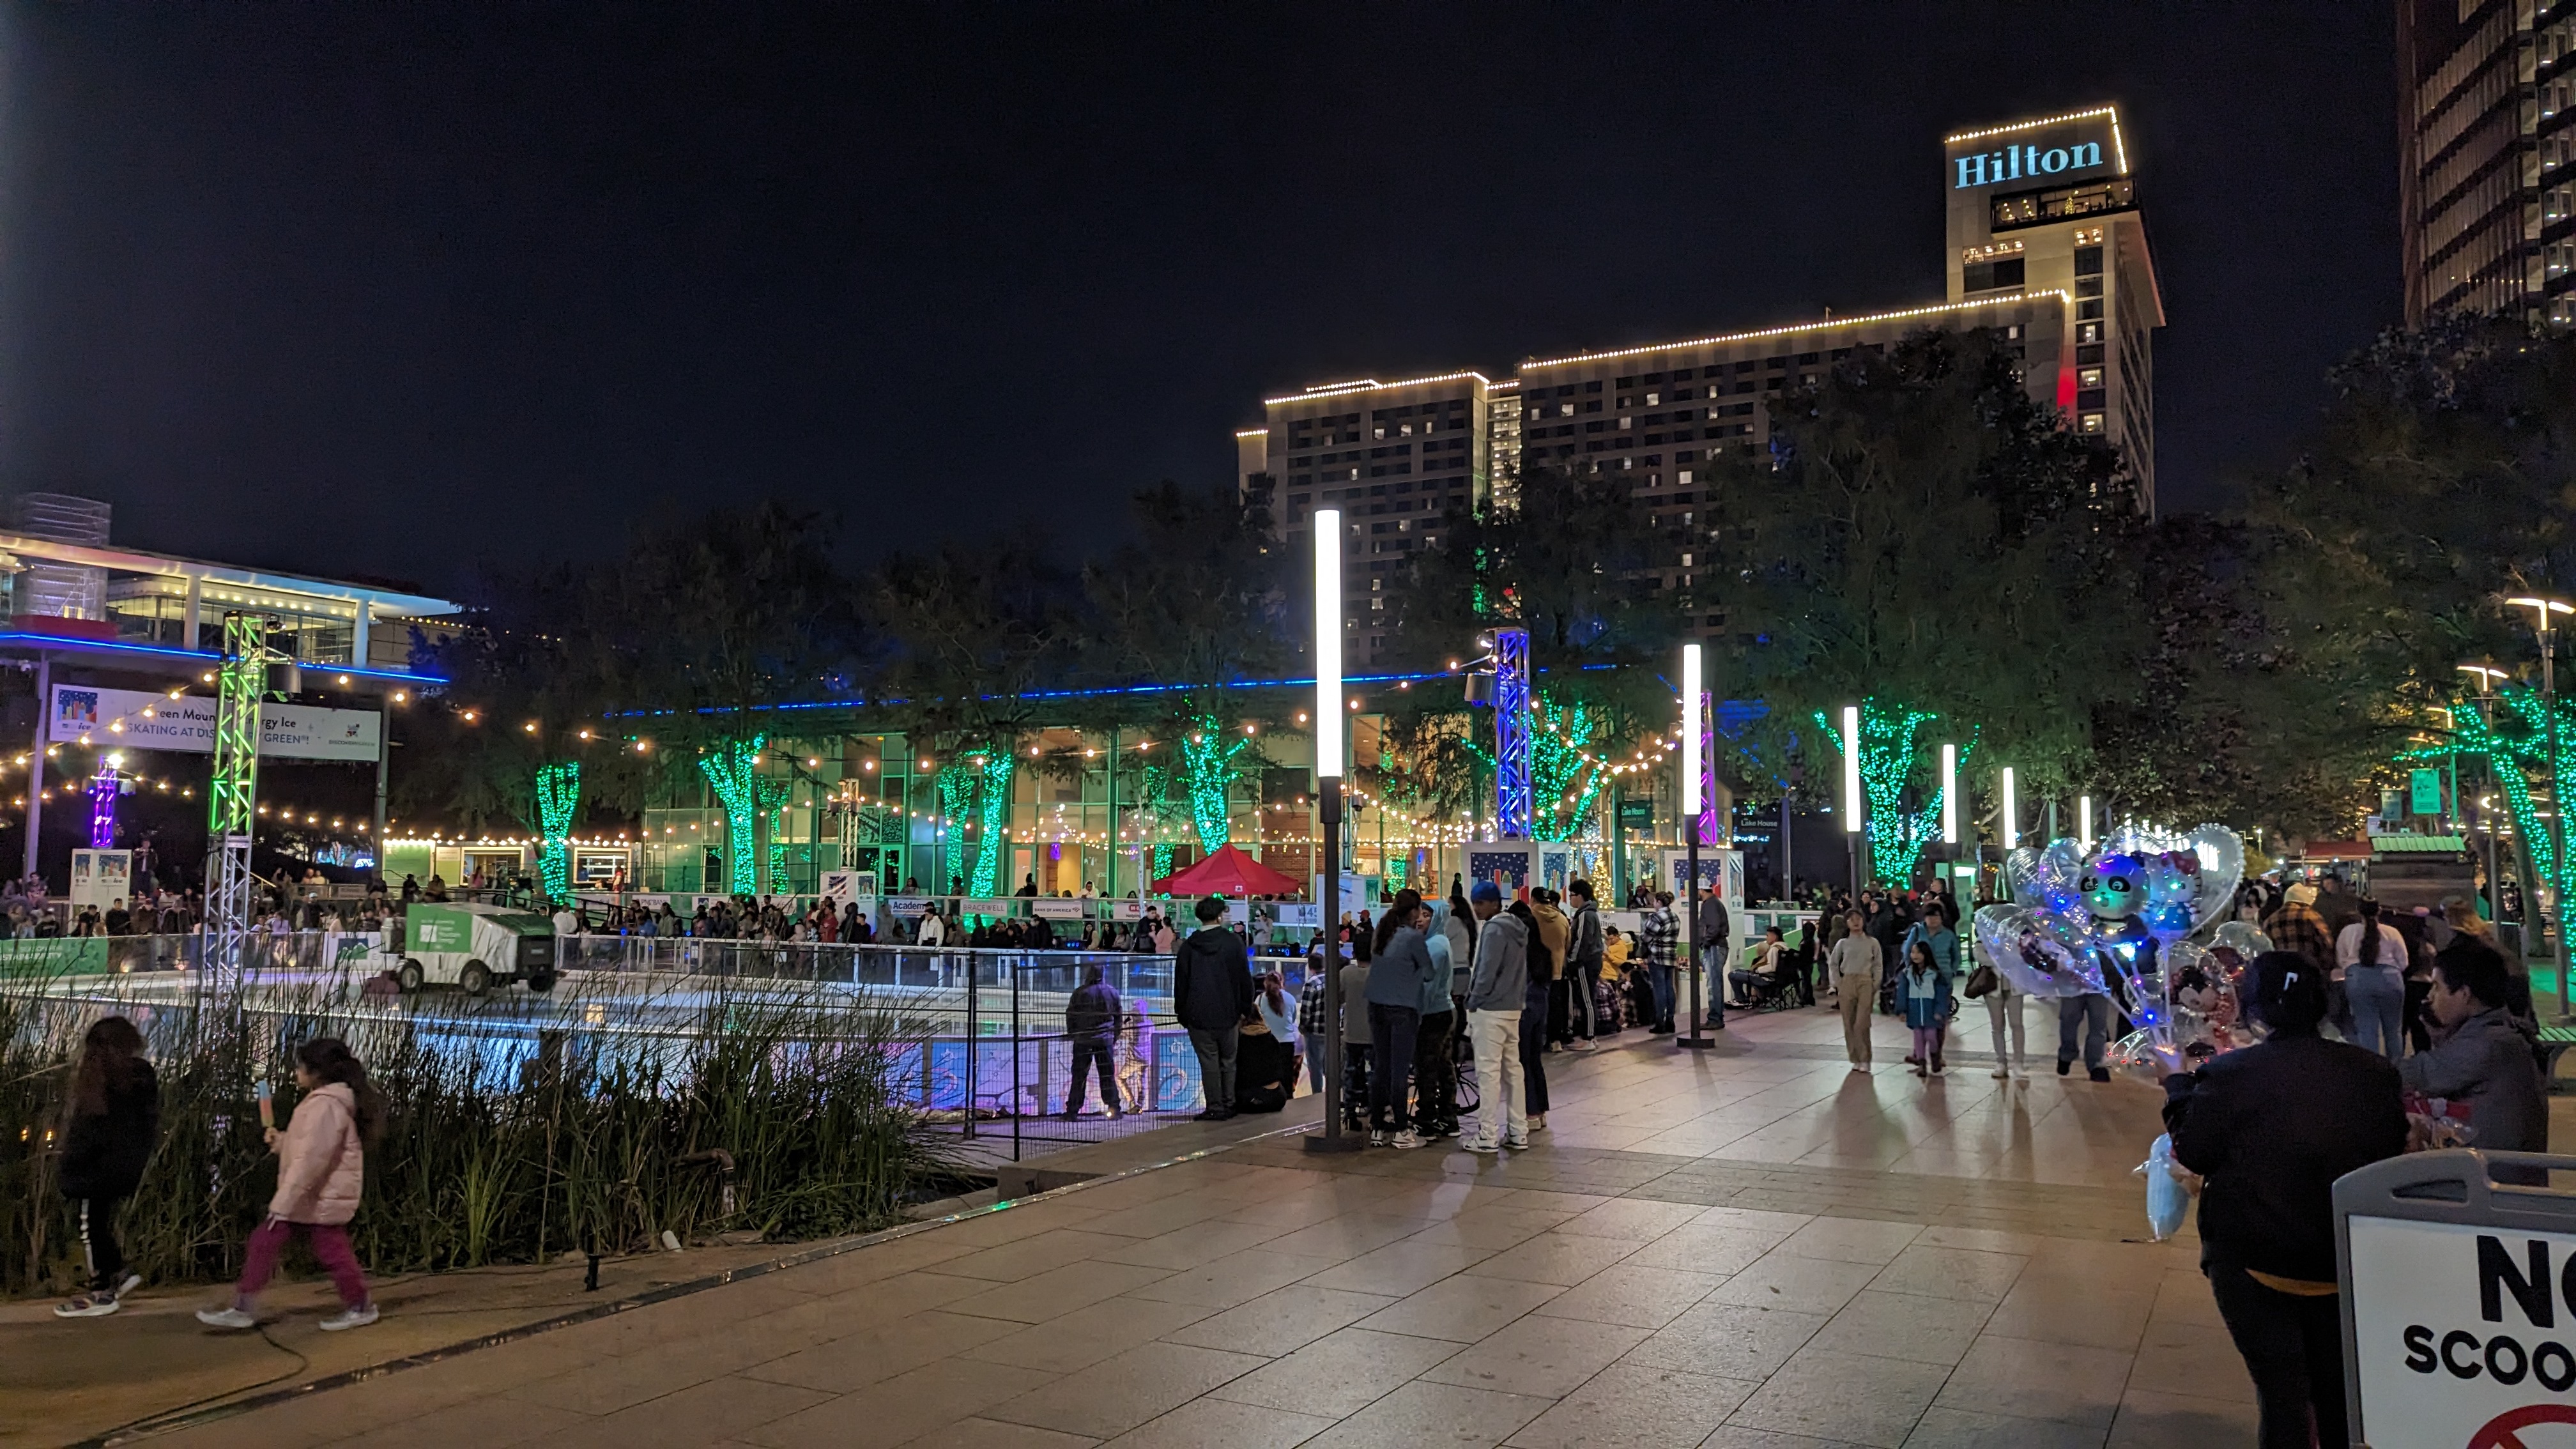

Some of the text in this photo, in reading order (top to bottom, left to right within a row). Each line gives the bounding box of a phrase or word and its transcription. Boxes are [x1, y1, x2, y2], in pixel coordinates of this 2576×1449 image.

[1954, 141, 2103, 190] Hilton
[152, 709, 180, 719] reen
[281, 716, 296, 728] Ice
[78, 722, 92, 730] ice
[127, 723, 177, 736] SKATING
[180, 727, 194, 737] AT
[1621, 808, 1632, 816] Lake
[1632, 807, 1645, 815] House
[893, 901, 925, 910] Academ
[2476, 1234, 2576, 1329] N
